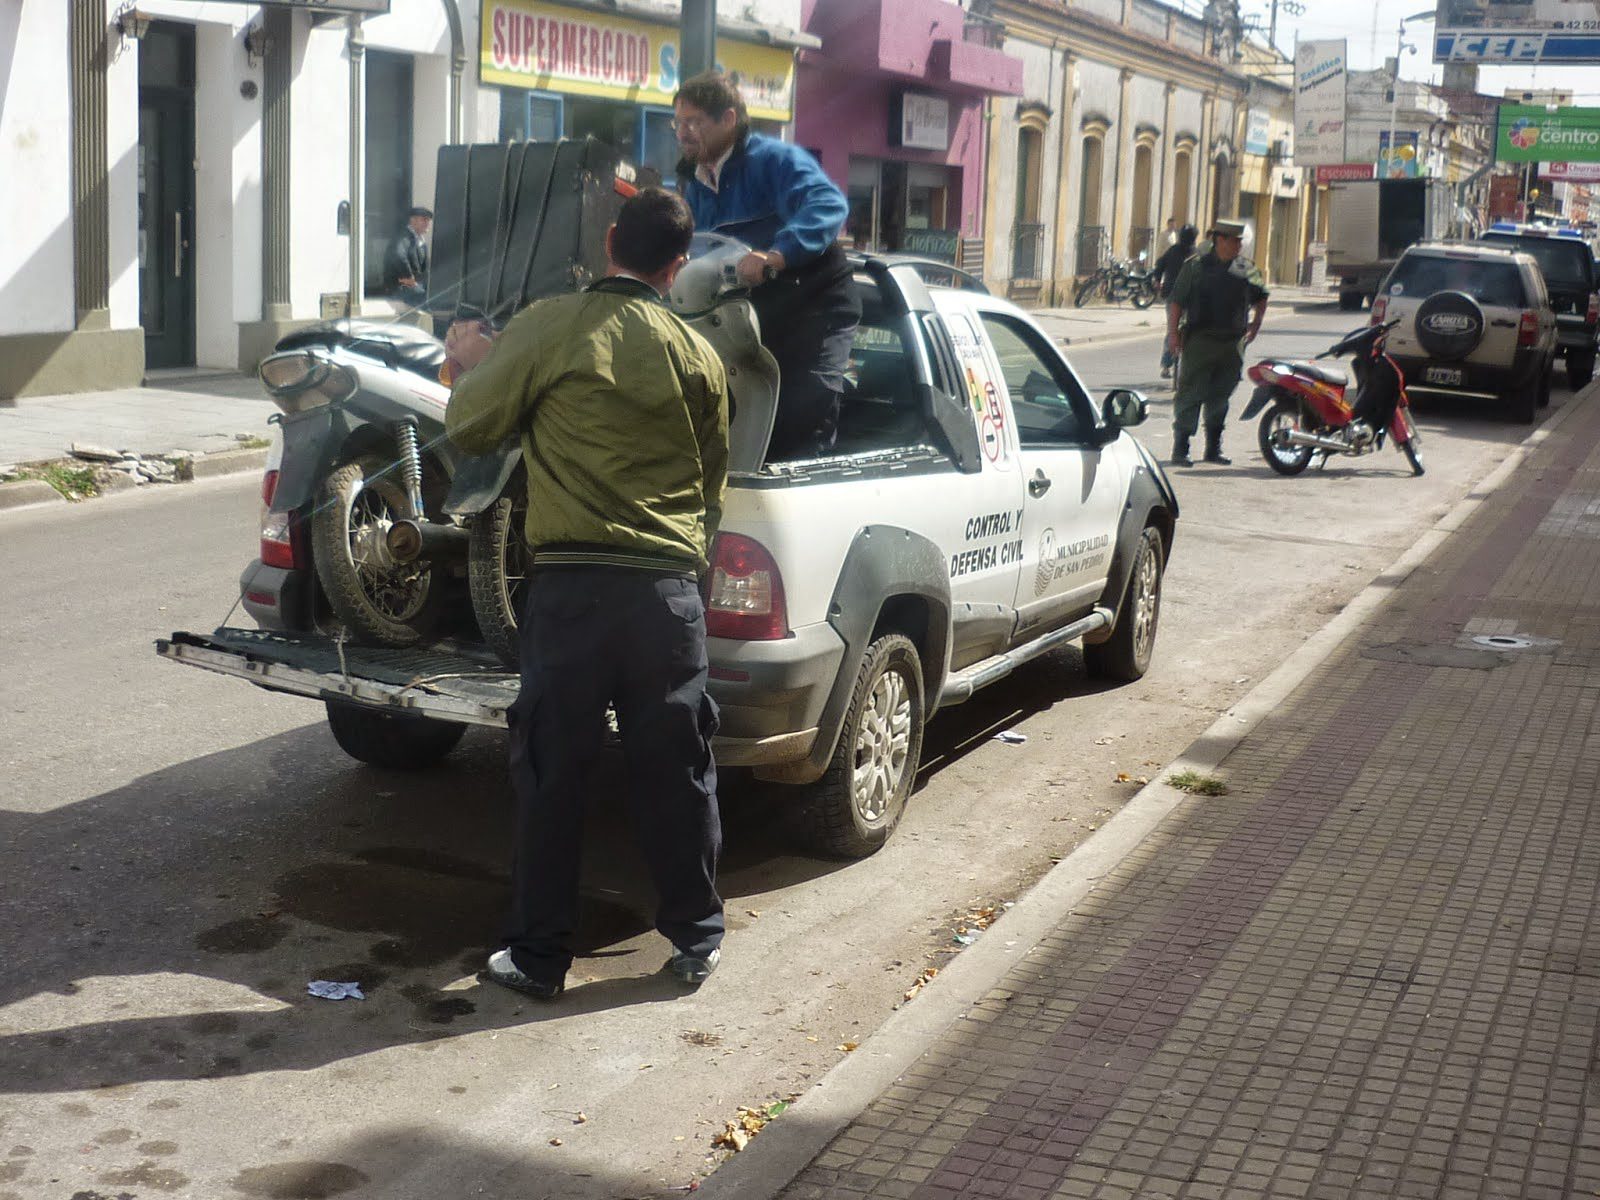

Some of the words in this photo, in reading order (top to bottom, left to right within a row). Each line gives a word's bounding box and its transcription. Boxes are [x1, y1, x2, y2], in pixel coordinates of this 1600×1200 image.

[494, 8, 649, 85] SUPERMERCADO
[1541, 128, 1599, 144] centro
[965, 512, 1012, 541] CONTROL
[1014, 508, 1024, 532] Y
[950, 544, 997, 578] DEFENSA
[1001, 539, 1024, 565] CIVIL
[1057, 533, 1109, 560] MUNICIPALIDAD
[1053, 563, 1065, 580] DE
[1065, 558, 1081, 576] SAN
[1080, 552, 1104, 571] PEDRO
